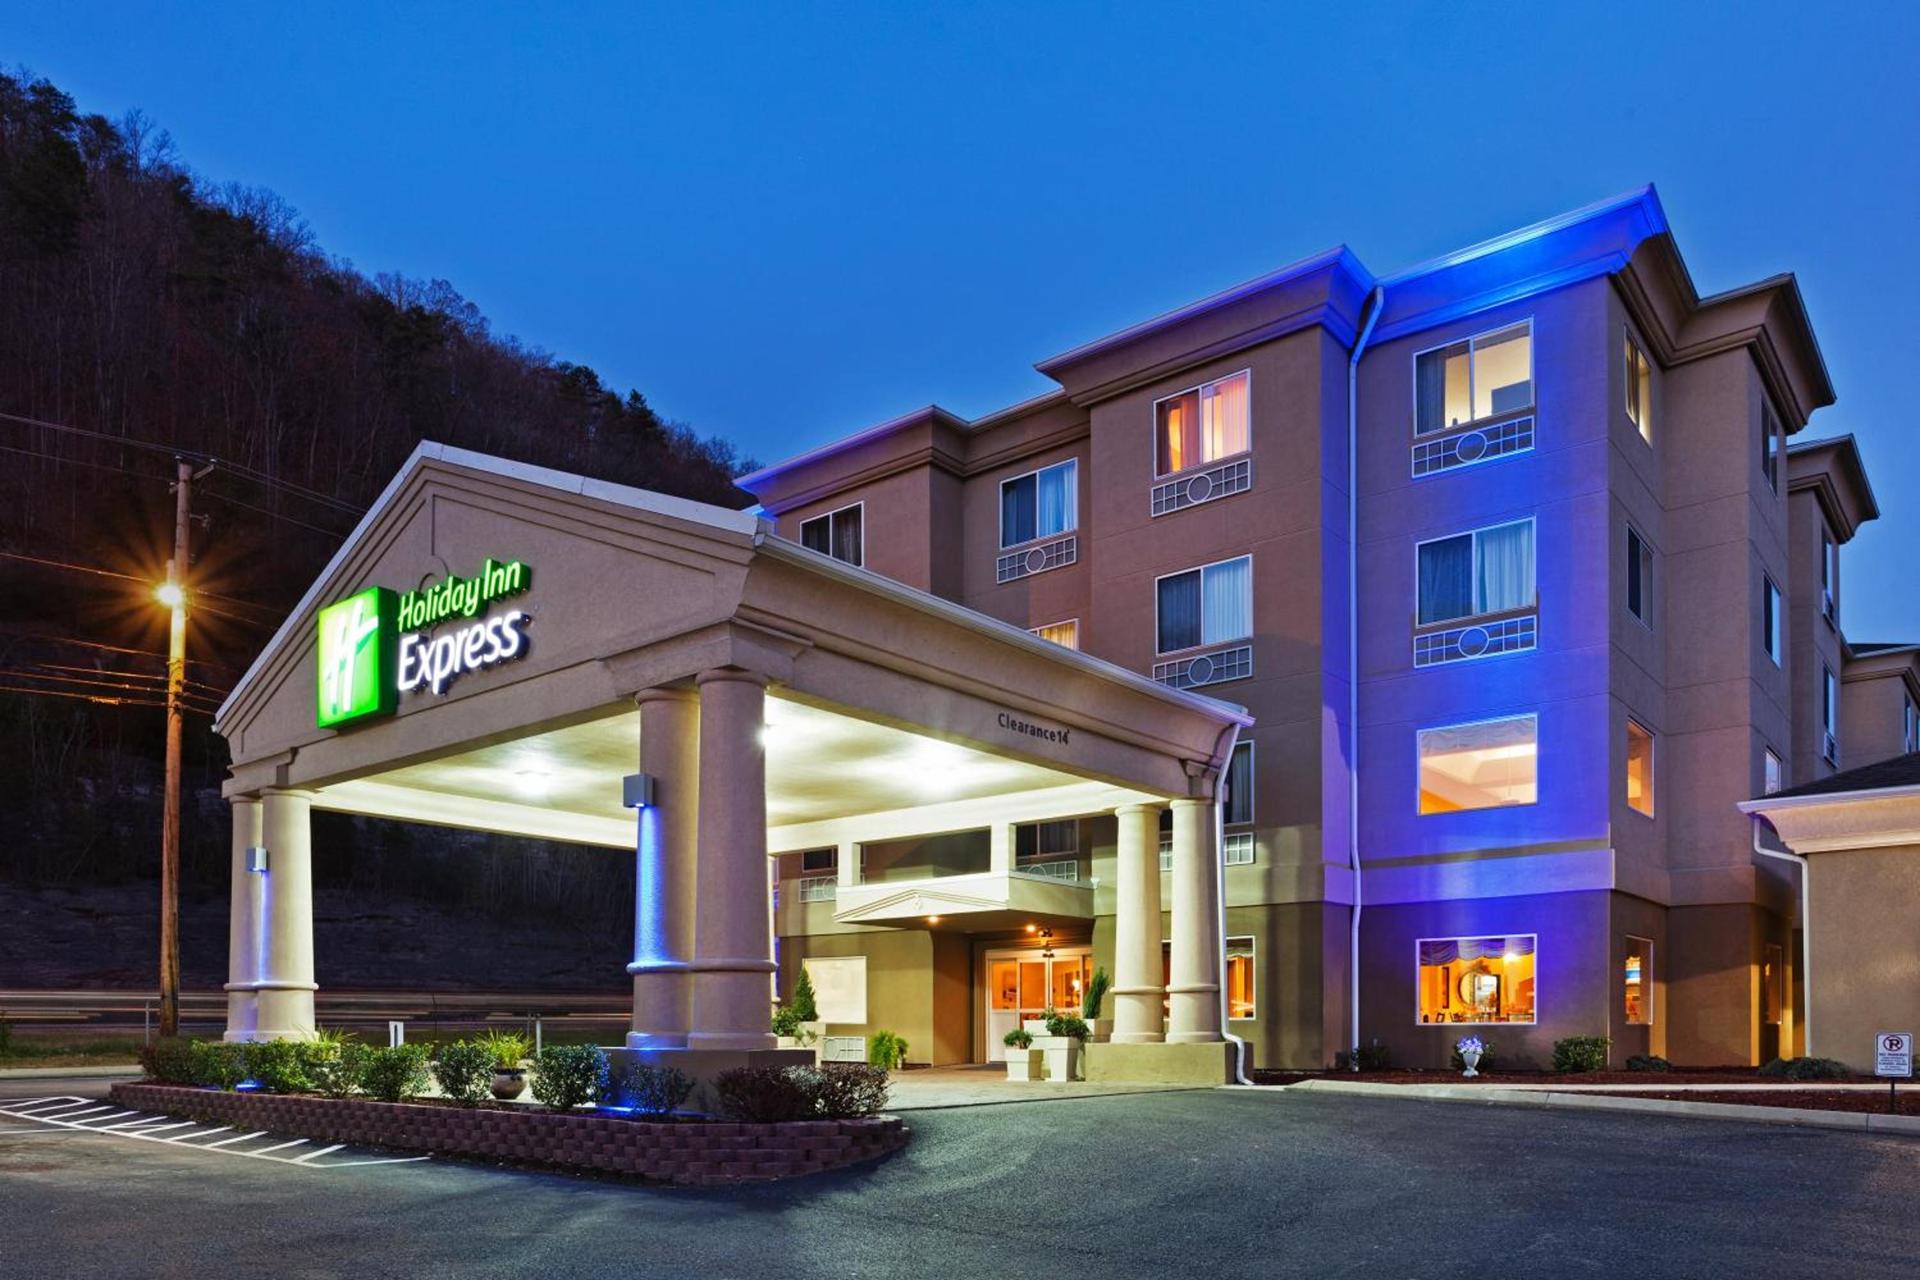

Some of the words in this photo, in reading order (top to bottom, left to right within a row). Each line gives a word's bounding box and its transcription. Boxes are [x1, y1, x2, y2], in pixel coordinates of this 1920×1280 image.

[398, 575, 483, 632] Holiday
[482, 558, 525, 601] Inn
[398, 610, 524, 695] Express
[998, 712, 1056, 742] Clearance
